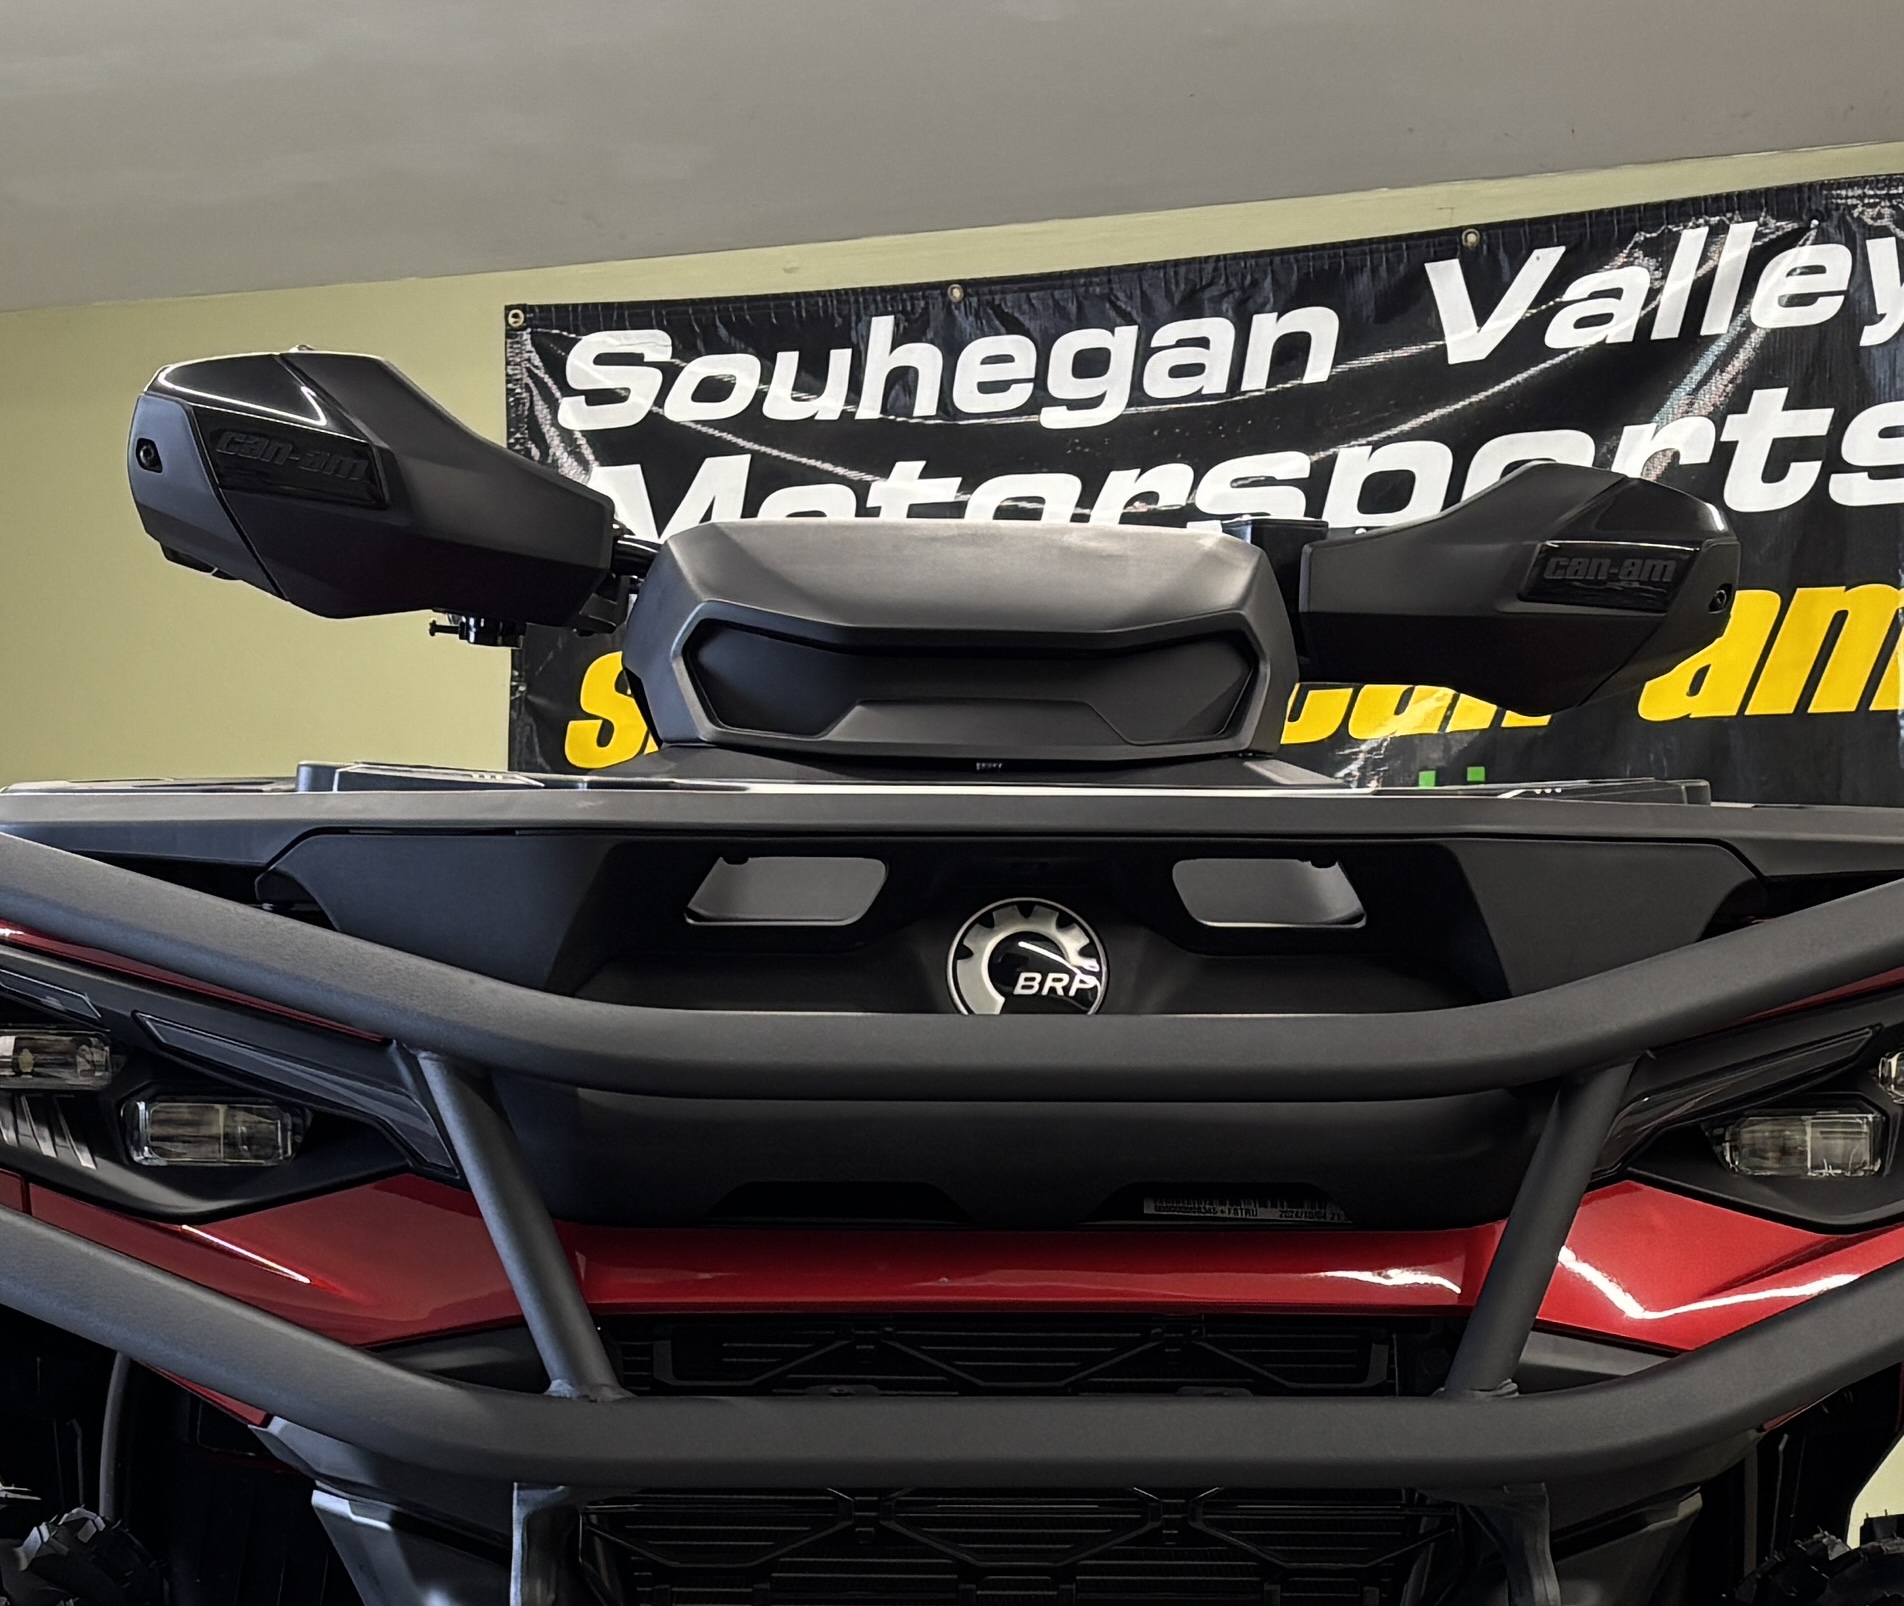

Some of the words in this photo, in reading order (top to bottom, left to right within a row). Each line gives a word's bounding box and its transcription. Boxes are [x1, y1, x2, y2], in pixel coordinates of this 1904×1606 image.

[557, 304, 1339, 431] Souhegan
[1543, 556, 1678, 583] can-am
[1013, 972, 1097, 997] BRP
